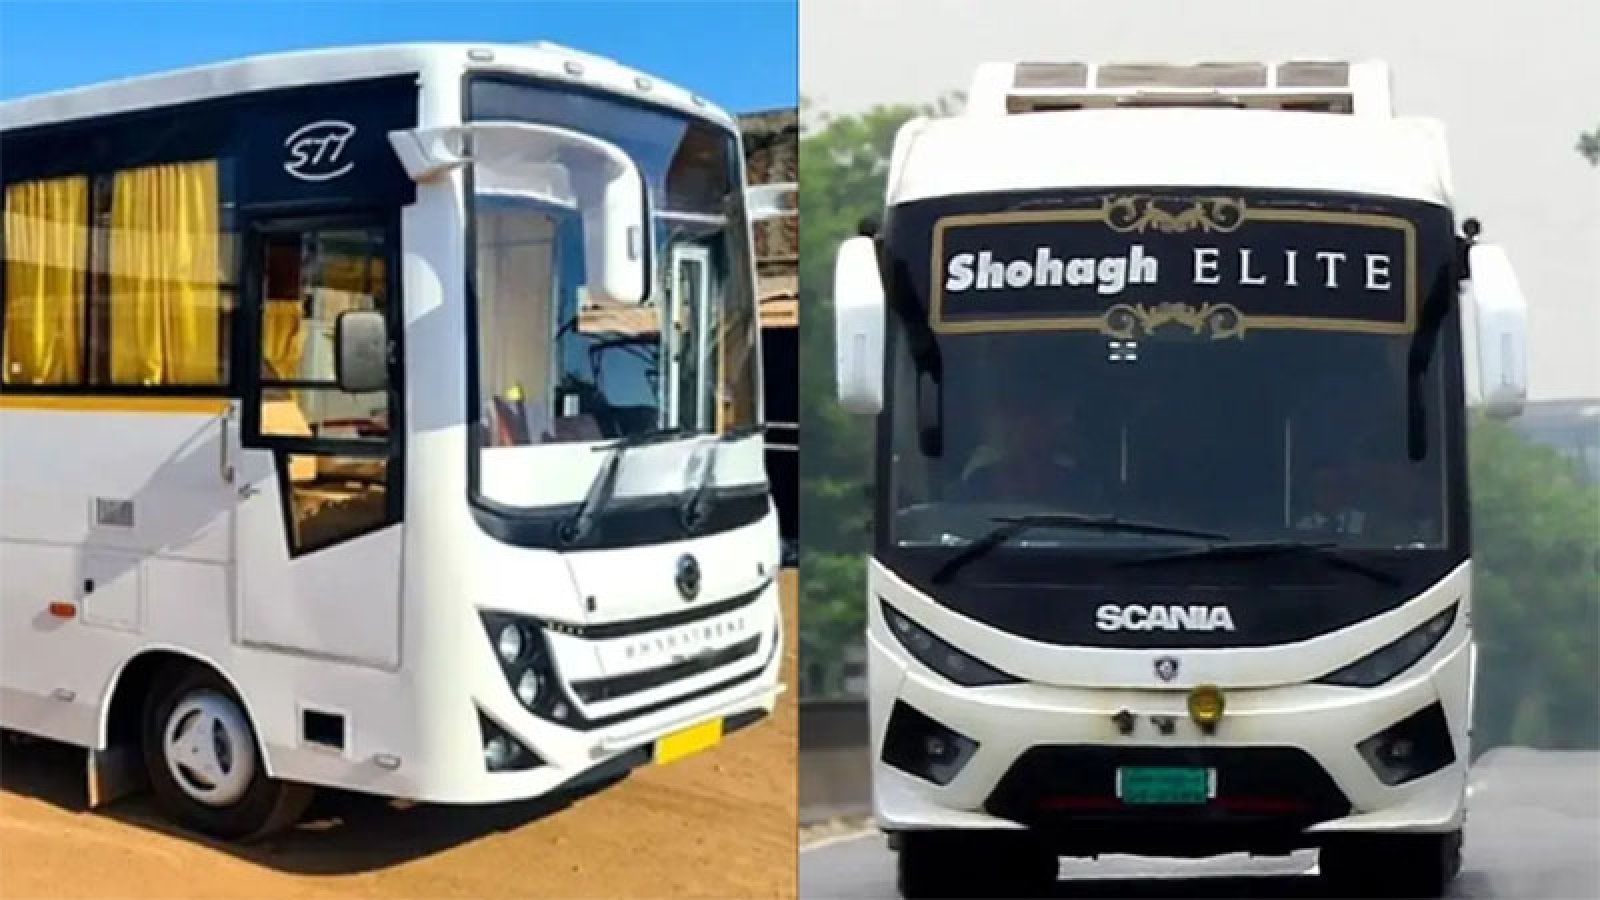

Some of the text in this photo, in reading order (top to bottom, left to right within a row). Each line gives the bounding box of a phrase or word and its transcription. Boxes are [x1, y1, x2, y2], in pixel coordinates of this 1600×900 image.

[946, 245, 1392, 294] Shohagh ELITE
[1096, 604, 1236, 631] SCANIA
